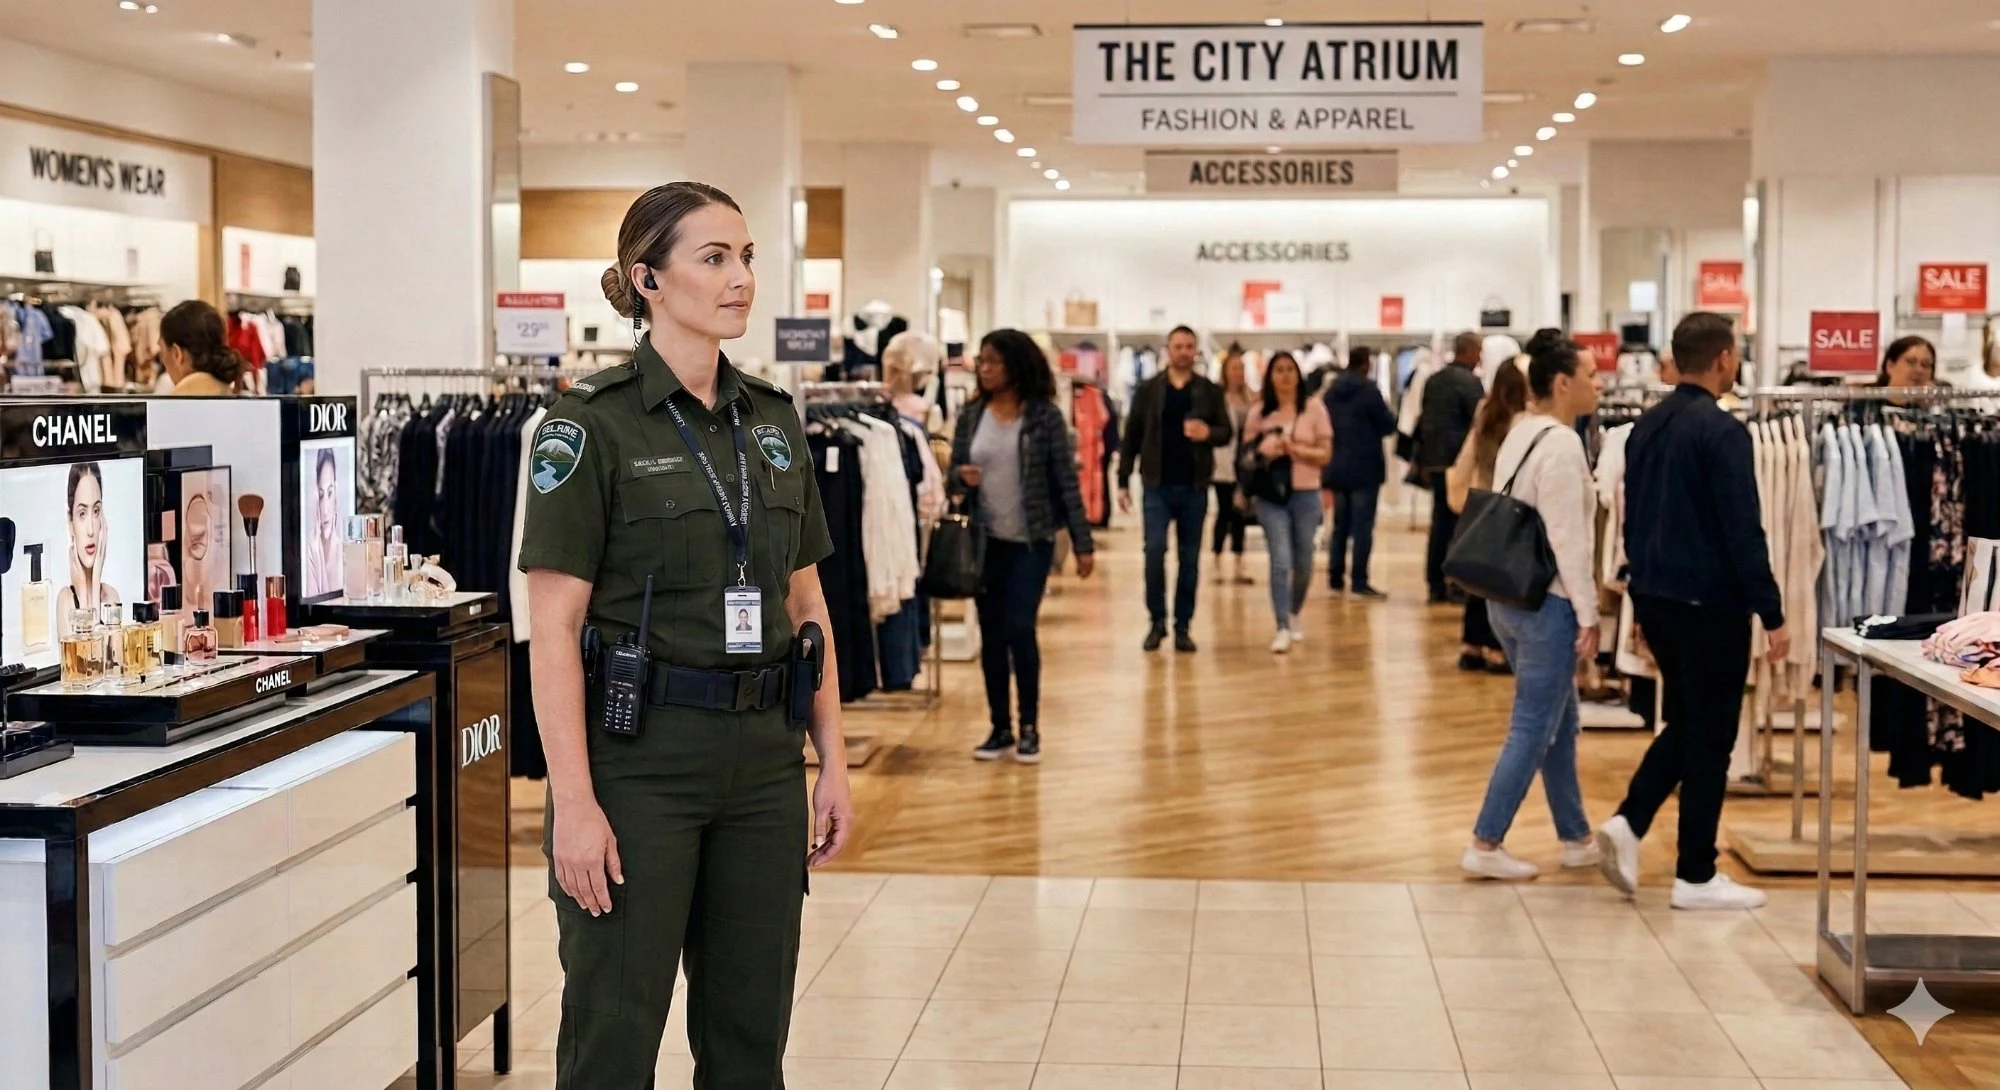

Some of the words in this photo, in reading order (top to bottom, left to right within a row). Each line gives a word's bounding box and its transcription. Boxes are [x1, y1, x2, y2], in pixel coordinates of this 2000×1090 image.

[1098, 41, 1175, 82] THE
[1193, 40, 1285, 82] CITY
[1301, 39, 1458, 81] ATRIUM
[1141, 108, 1258, 131] FASHION
[1268, 107, 1285, 131] &
[1296, 107, 1414, 130] APPAREL
[30, 146, 115, 191] WOMEN'S
[119, 160, 165, 197] WEAR
[1190, 160, 1354, 185] ACCESSORIES
[1197, 242, 1351, 262] ACCESSORIES
[1923, 267, 1982, 290] SALE
[1815, 329, 1874, 349] SALE
[309, 402, 348, 433] DIOR
[32, 413, 118, 448] CHANEL
[255, 669, 292, 694] CHANEL
[461, 714, 502, 769] DIOR
